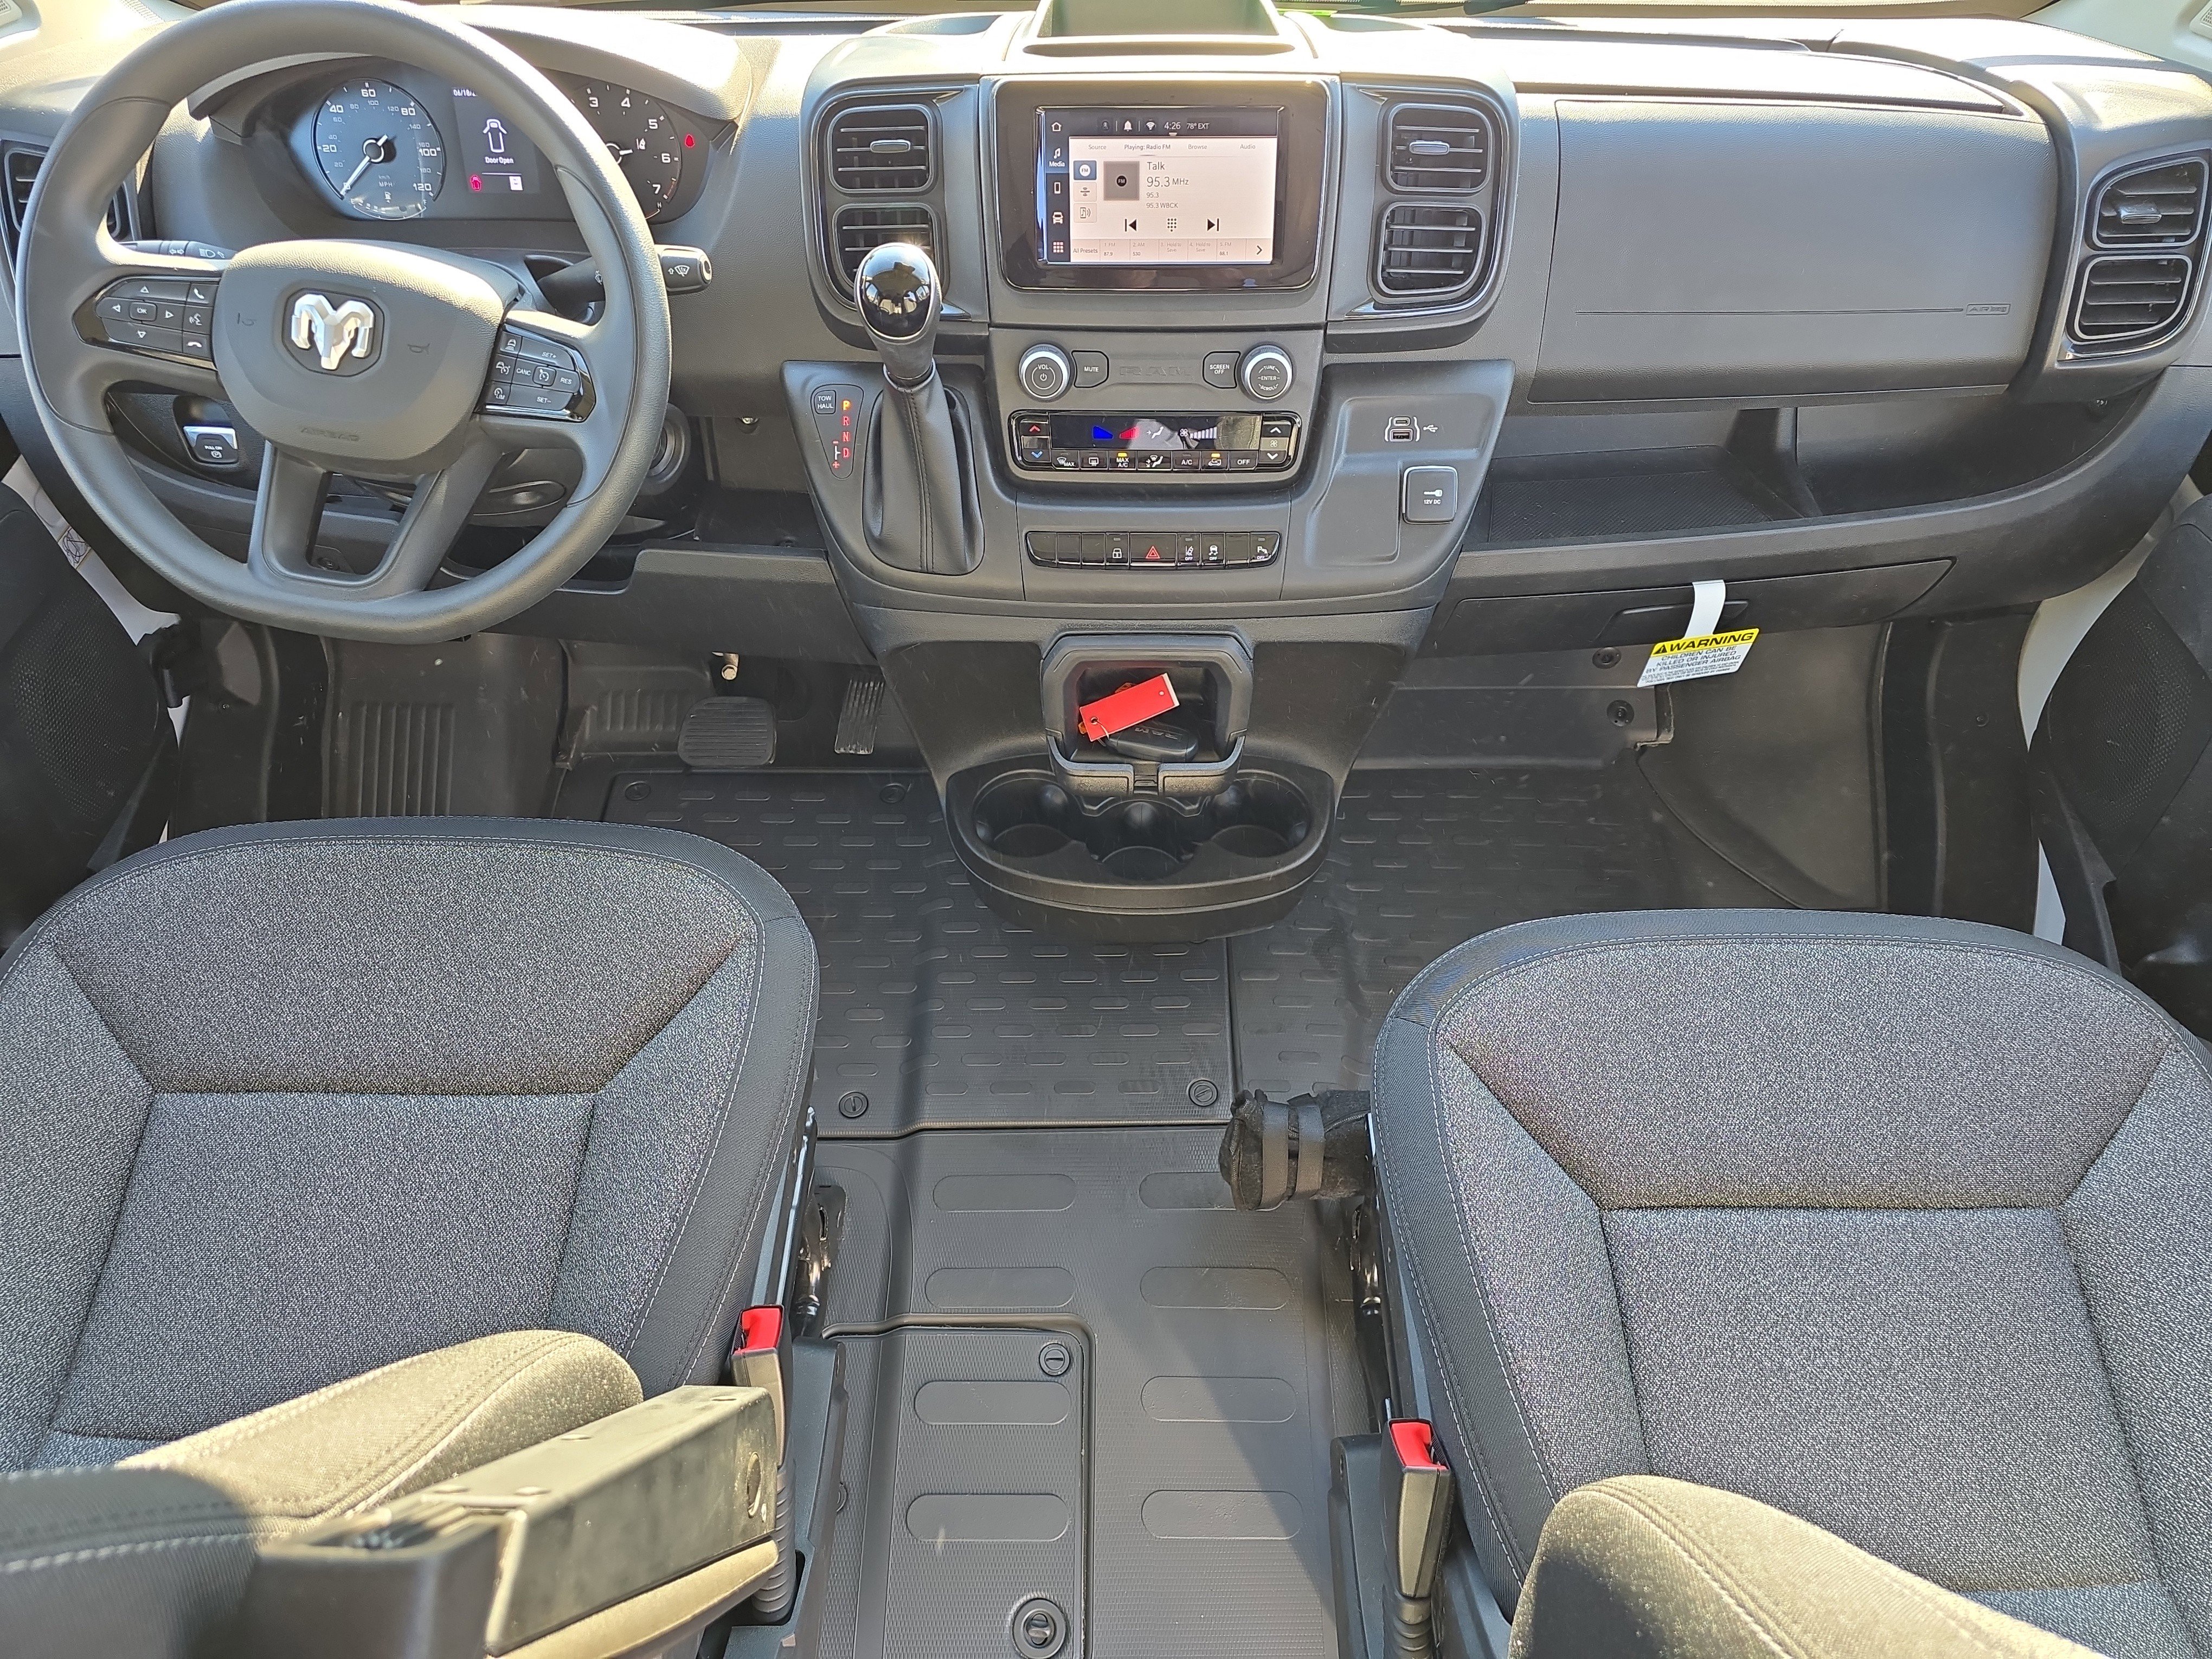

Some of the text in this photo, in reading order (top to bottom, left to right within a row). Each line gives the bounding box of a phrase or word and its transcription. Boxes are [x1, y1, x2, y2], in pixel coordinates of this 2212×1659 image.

[361, 89, 376, 97] 60
[589, 97, 599, 107] 3
[621, 98, 631, 107] 4
[648, 119, 658, 130] 5
[499, 157, 515, 165] Open
[661, 153, 671, 163] 6
[1147, 162, 1165, 170] Talk
[1147, 176, 1171, 188] 95.3
[652, 184, 661, 194] 7
[516, 368, 531, 376] CANC
[1120, 366, 1191, 376] RAM
[560, 377, 573, 385] RES
[843, 400, 851, 411] P
[843, 415, 850, 426] R
[843, 432, 850, 442] N
[843, 447, 850, 458] D
[1670, 633, 1754, 652] WARNING
[1656, 658, 1684, 666] KILLED
[1701, 651, 1737, 660] INJURED
[1662, 651, 1703, 661] CHILDREN
[1659, 660, 1708, 671] PASSENGER
[1710, 655, 1741, 664] AIRBAG
